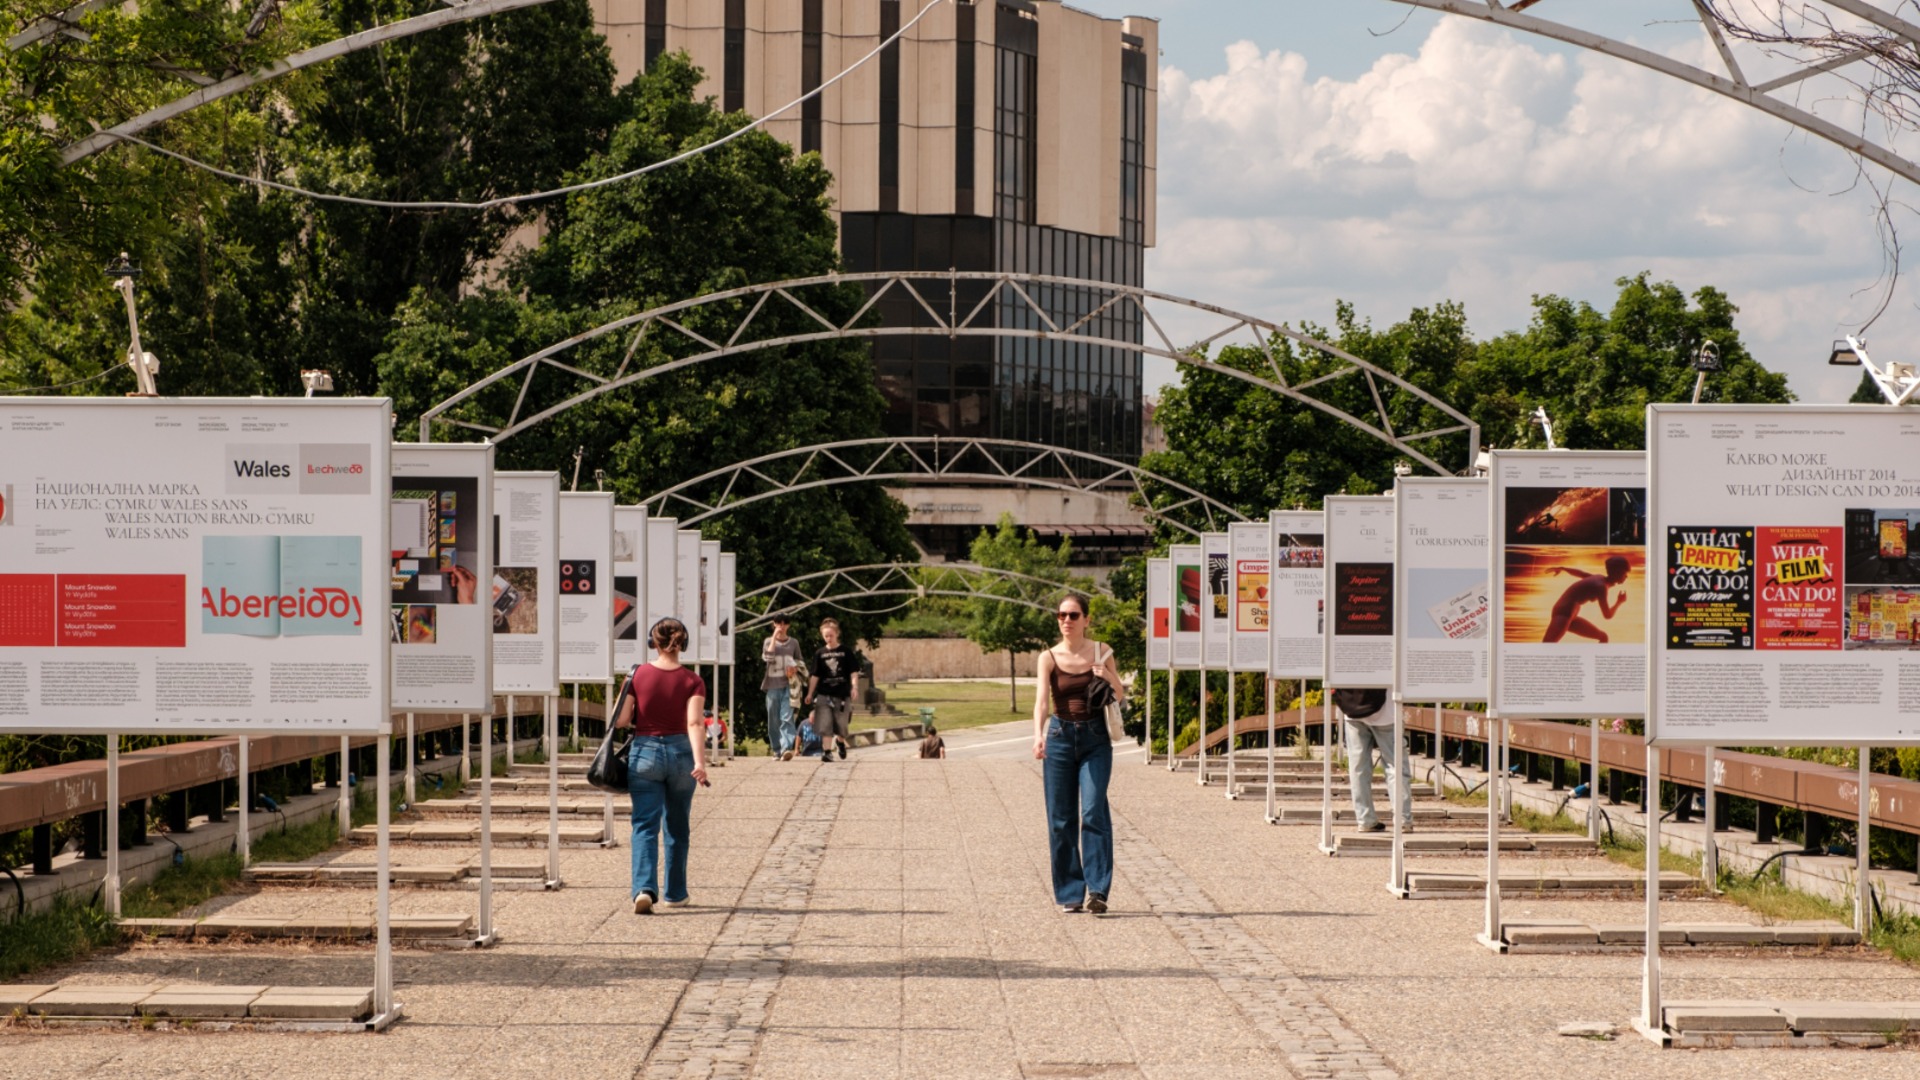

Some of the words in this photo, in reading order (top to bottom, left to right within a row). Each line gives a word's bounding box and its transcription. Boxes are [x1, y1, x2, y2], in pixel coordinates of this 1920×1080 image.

[1726, 453, 1777, 465] КАКВО
[1781, 453, 1827, 465] МОЖЕ
[234, 460, 291, 478] Wales
[1782, 467, 1866, 481] ДИЗАЙНЪТ
[1868, 469, 1896, 480] 2014
[35, 483, 145, 496] НАЦИОНАЛНА
[148, 483, 200, 495] МАРКА
[1726, 484, 1771, 497] WHAT
[1775, 484, 1829, 497] DESIGN
[1832, 484, 1864, 497] CAN
[1868, 484, 1890, 497] DO
[35, 499, 57, 510] НА
[61, 499, 102, 510] УЕЛС:
[105, 499, 157, 511] CYMRU
[160, 499, 208, 511] WALES
[211, 499, 248, 511] SANS
[105, 512, 151, 524] WALES
[153, 512, 208, 524] NATION
[211, 513, 263, 525] BRAND:
[265, 513, 315, 525] CYMRU
[105, 527, 151, 539] WALES
[153, 527, 189, 539] SANS
[1408, 527, 1429, 536] THE
[1682, 532, 1741, 547] WHAT
[1685, 547, 1738, 568] PARTY
[1771, 545, 1829, 560] WHAT
[1781, 559, 1820, 579] FILM
[1672, 575, 1712, 590] CAN
[1716, 575, 1749, 590] DO!
[1762, 587, 1800, 601] CAN
[1805, 587, 1836, 601] DO!
[1449, 621, 1477, 639] news
